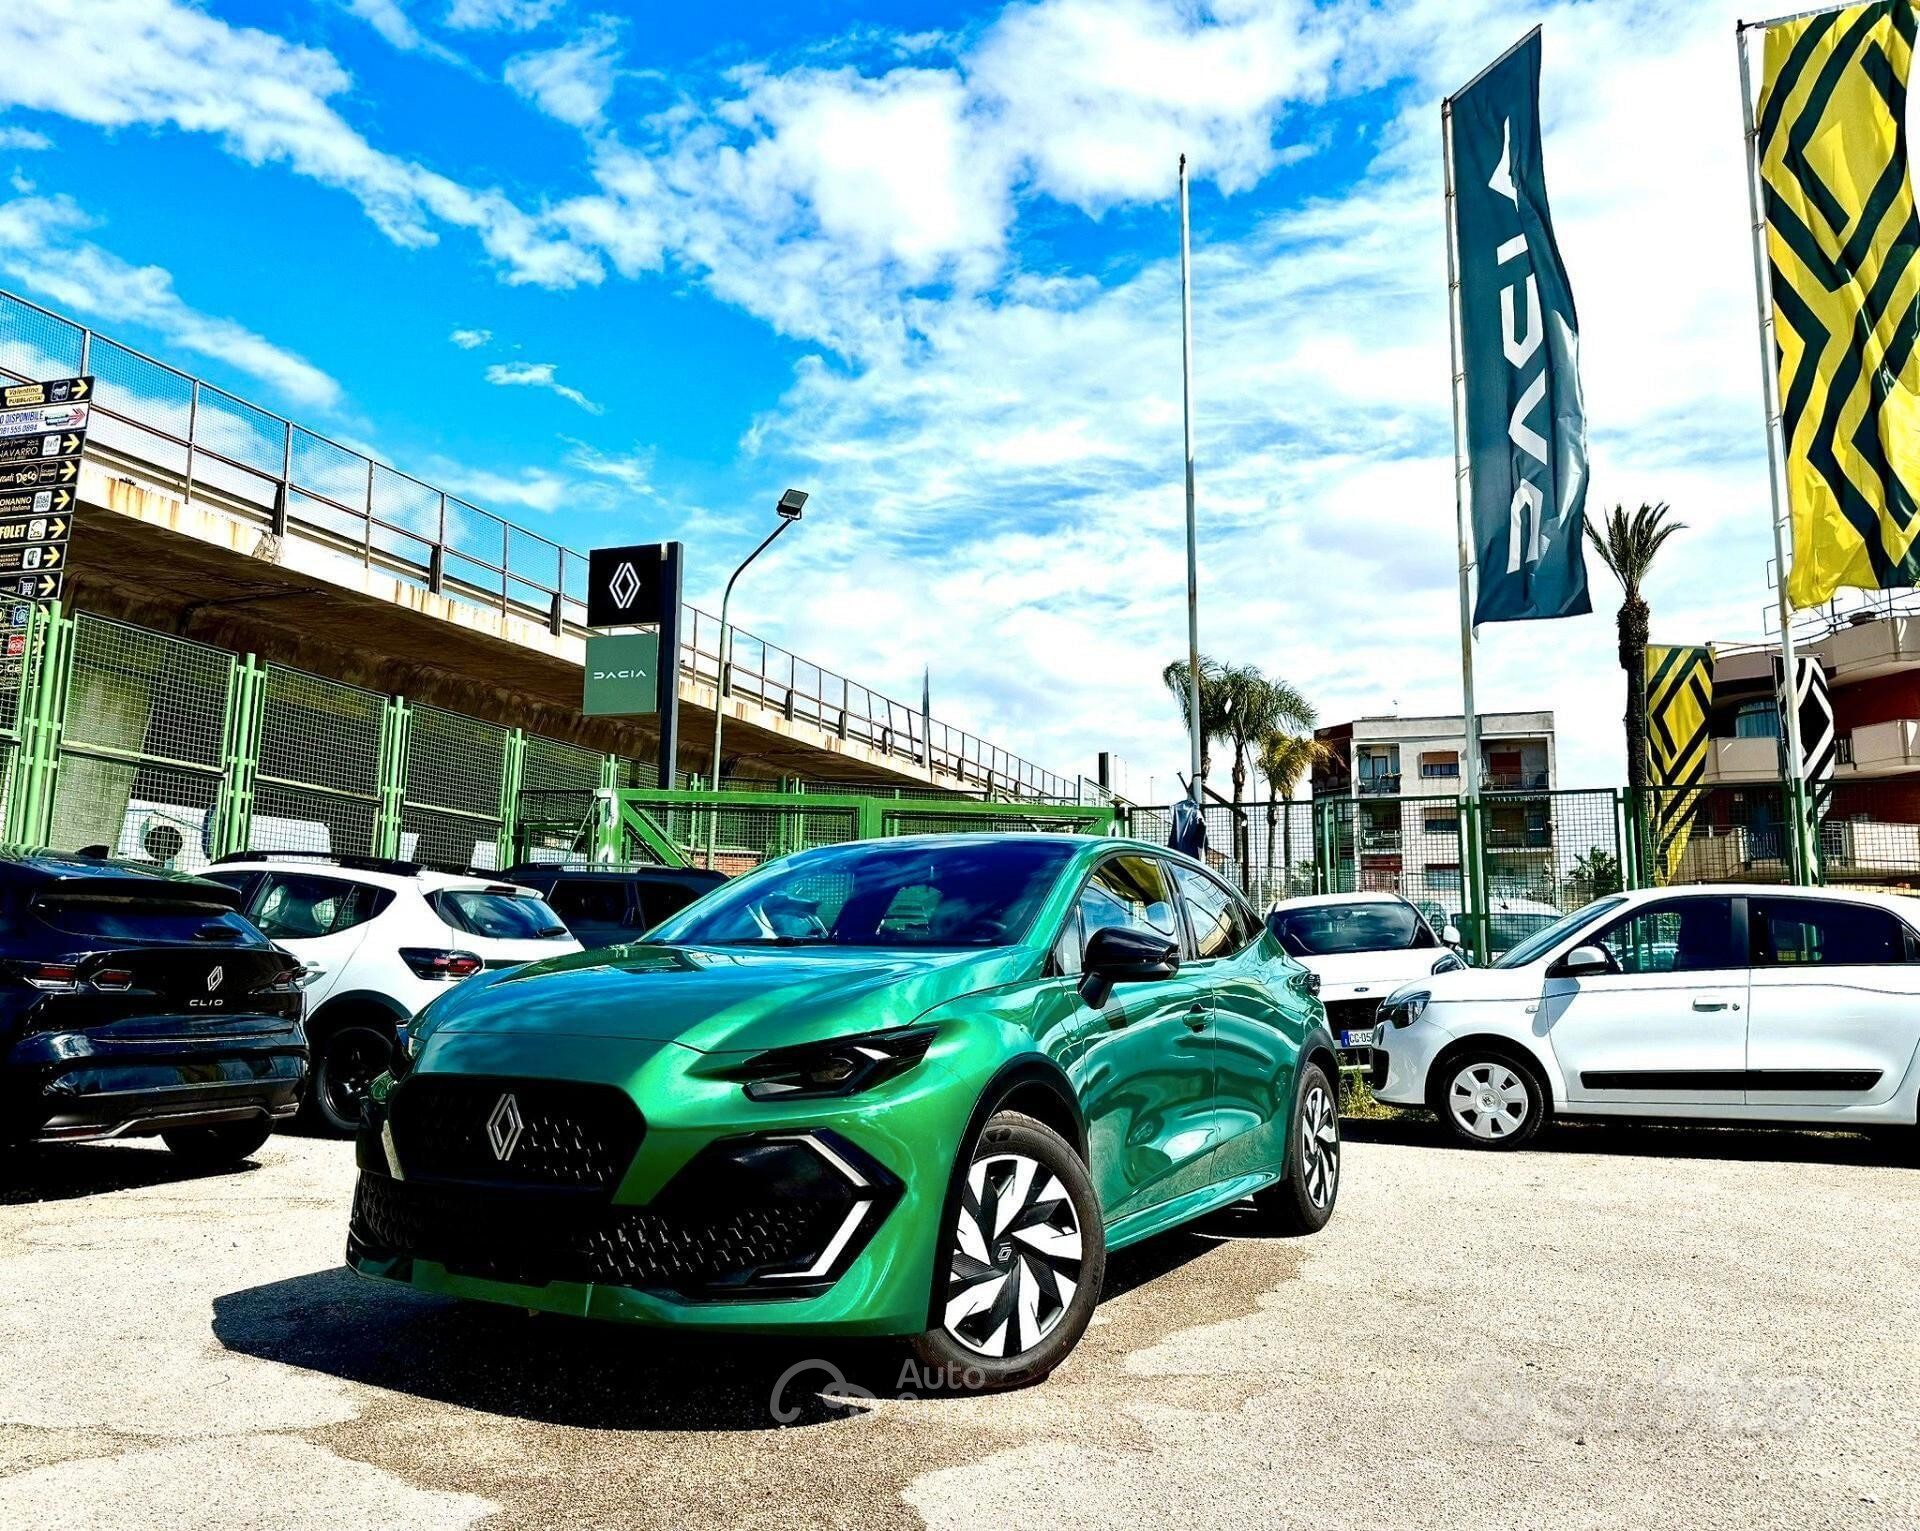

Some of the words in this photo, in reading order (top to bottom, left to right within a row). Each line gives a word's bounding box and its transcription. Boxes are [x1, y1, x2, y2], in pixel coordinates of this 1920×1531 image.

[1487, 114, 1551, 574] DACIA
[6, 410, 44, 423] DISPONIBILE
[593, 669, 646, 680] DACIA
[189, 999, 223, 1007] CLIO
